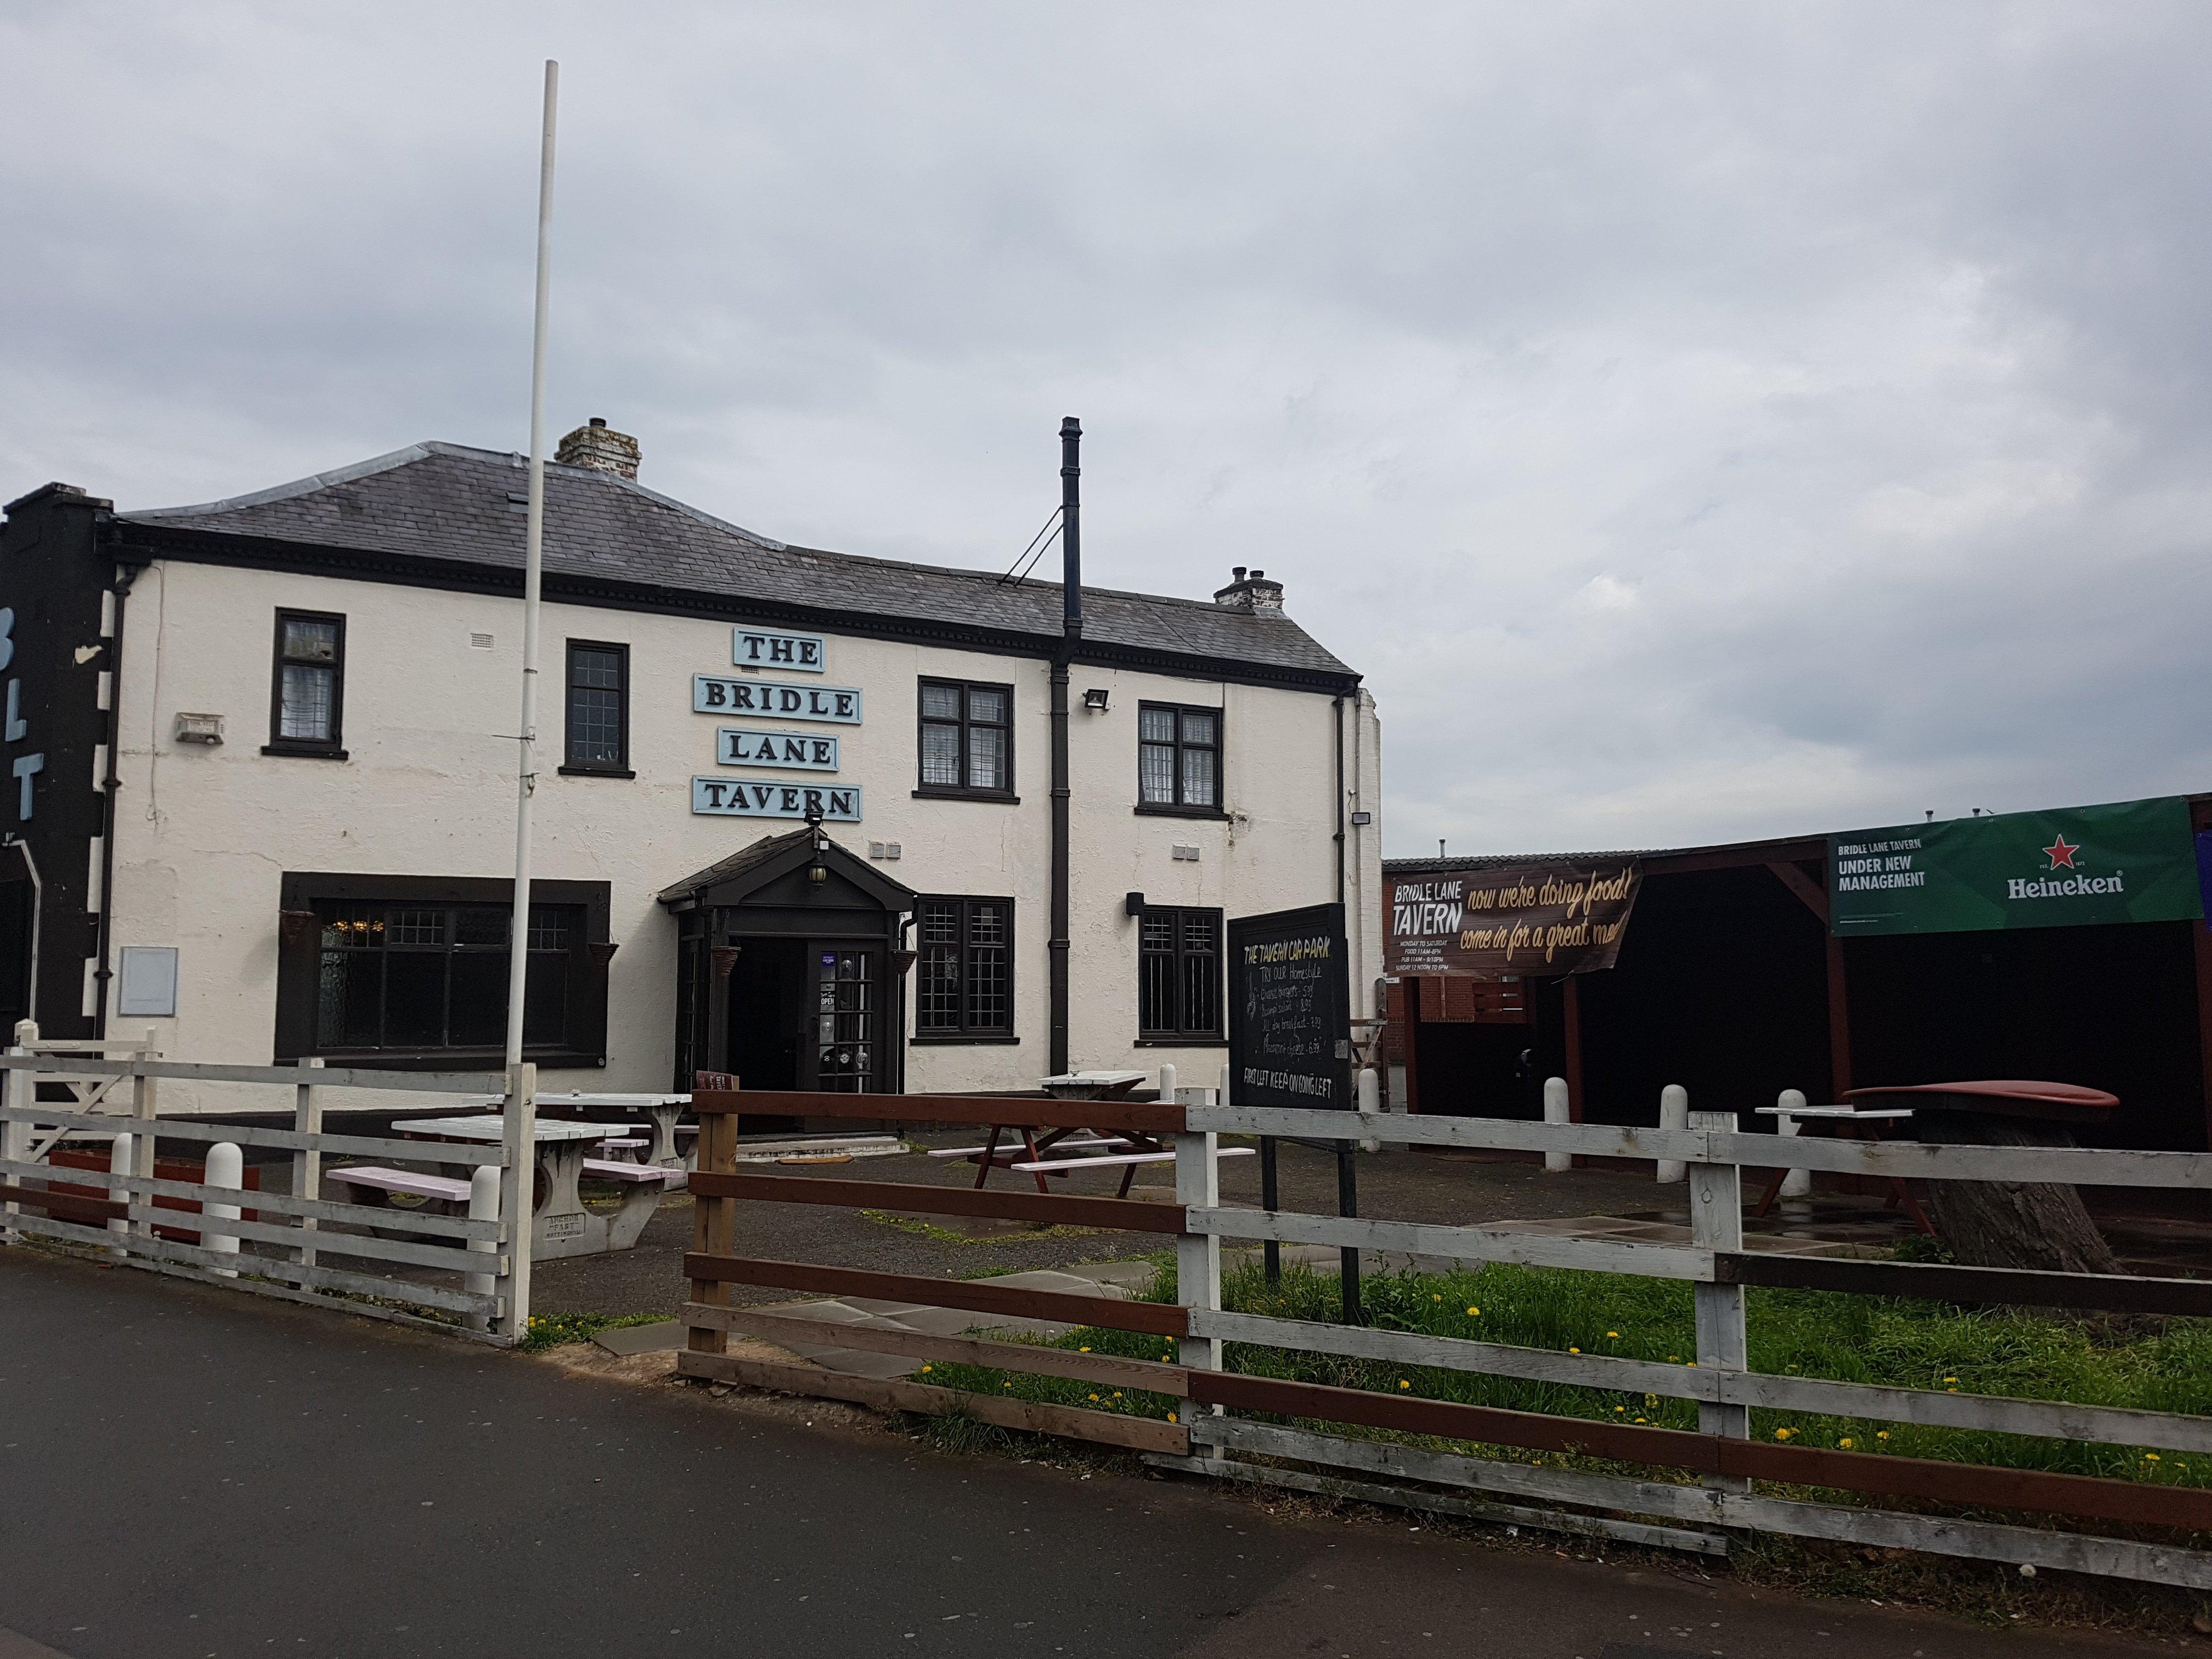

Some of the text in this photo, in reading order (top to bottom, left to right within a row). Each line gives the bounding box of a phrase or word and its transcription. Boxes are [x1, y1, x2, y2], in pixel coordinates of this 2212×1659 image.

[744, 636, 817, 664] THE
[706, 682, 853, 716] BRIDLE
[730, 735, 831, 763] LANE
[706, 784, 851, 814] TAVERN
[1838, 839, 1921, 856] BRIDLE LANE TAVERN
[1838, 855, 1912, 875] UNDER NEW
[1394, 881, 1463, 902] BRIDLE LANE
[1468, 867, 1632, 919] now we're doing food!
[1838, 871, 1925, 891] MANAGEMENT
[2007, 874, 2124, 899] Heineken
[1393, 902, 1462, 935] TAVERN
[1244, 935, 1330, 965] THE TAVERN CAR PARK
[1460, 929, 1492, 950] come
[1493, 925, 1508, 949] in
[1506, 918, 1529, 961] for
[1532, 929, 1545, 947] a
[1545, 917, 1590, 963] great
[1259, 961, 1322, 985] TRY OUR Homestyle
[1278, 1000, 1293, 1013] salad
[1272, 1018, 1280, 1034] day
[1244, 1068, 1331, 1099] FIRST LEFT KEEP ON GOING LEFT
